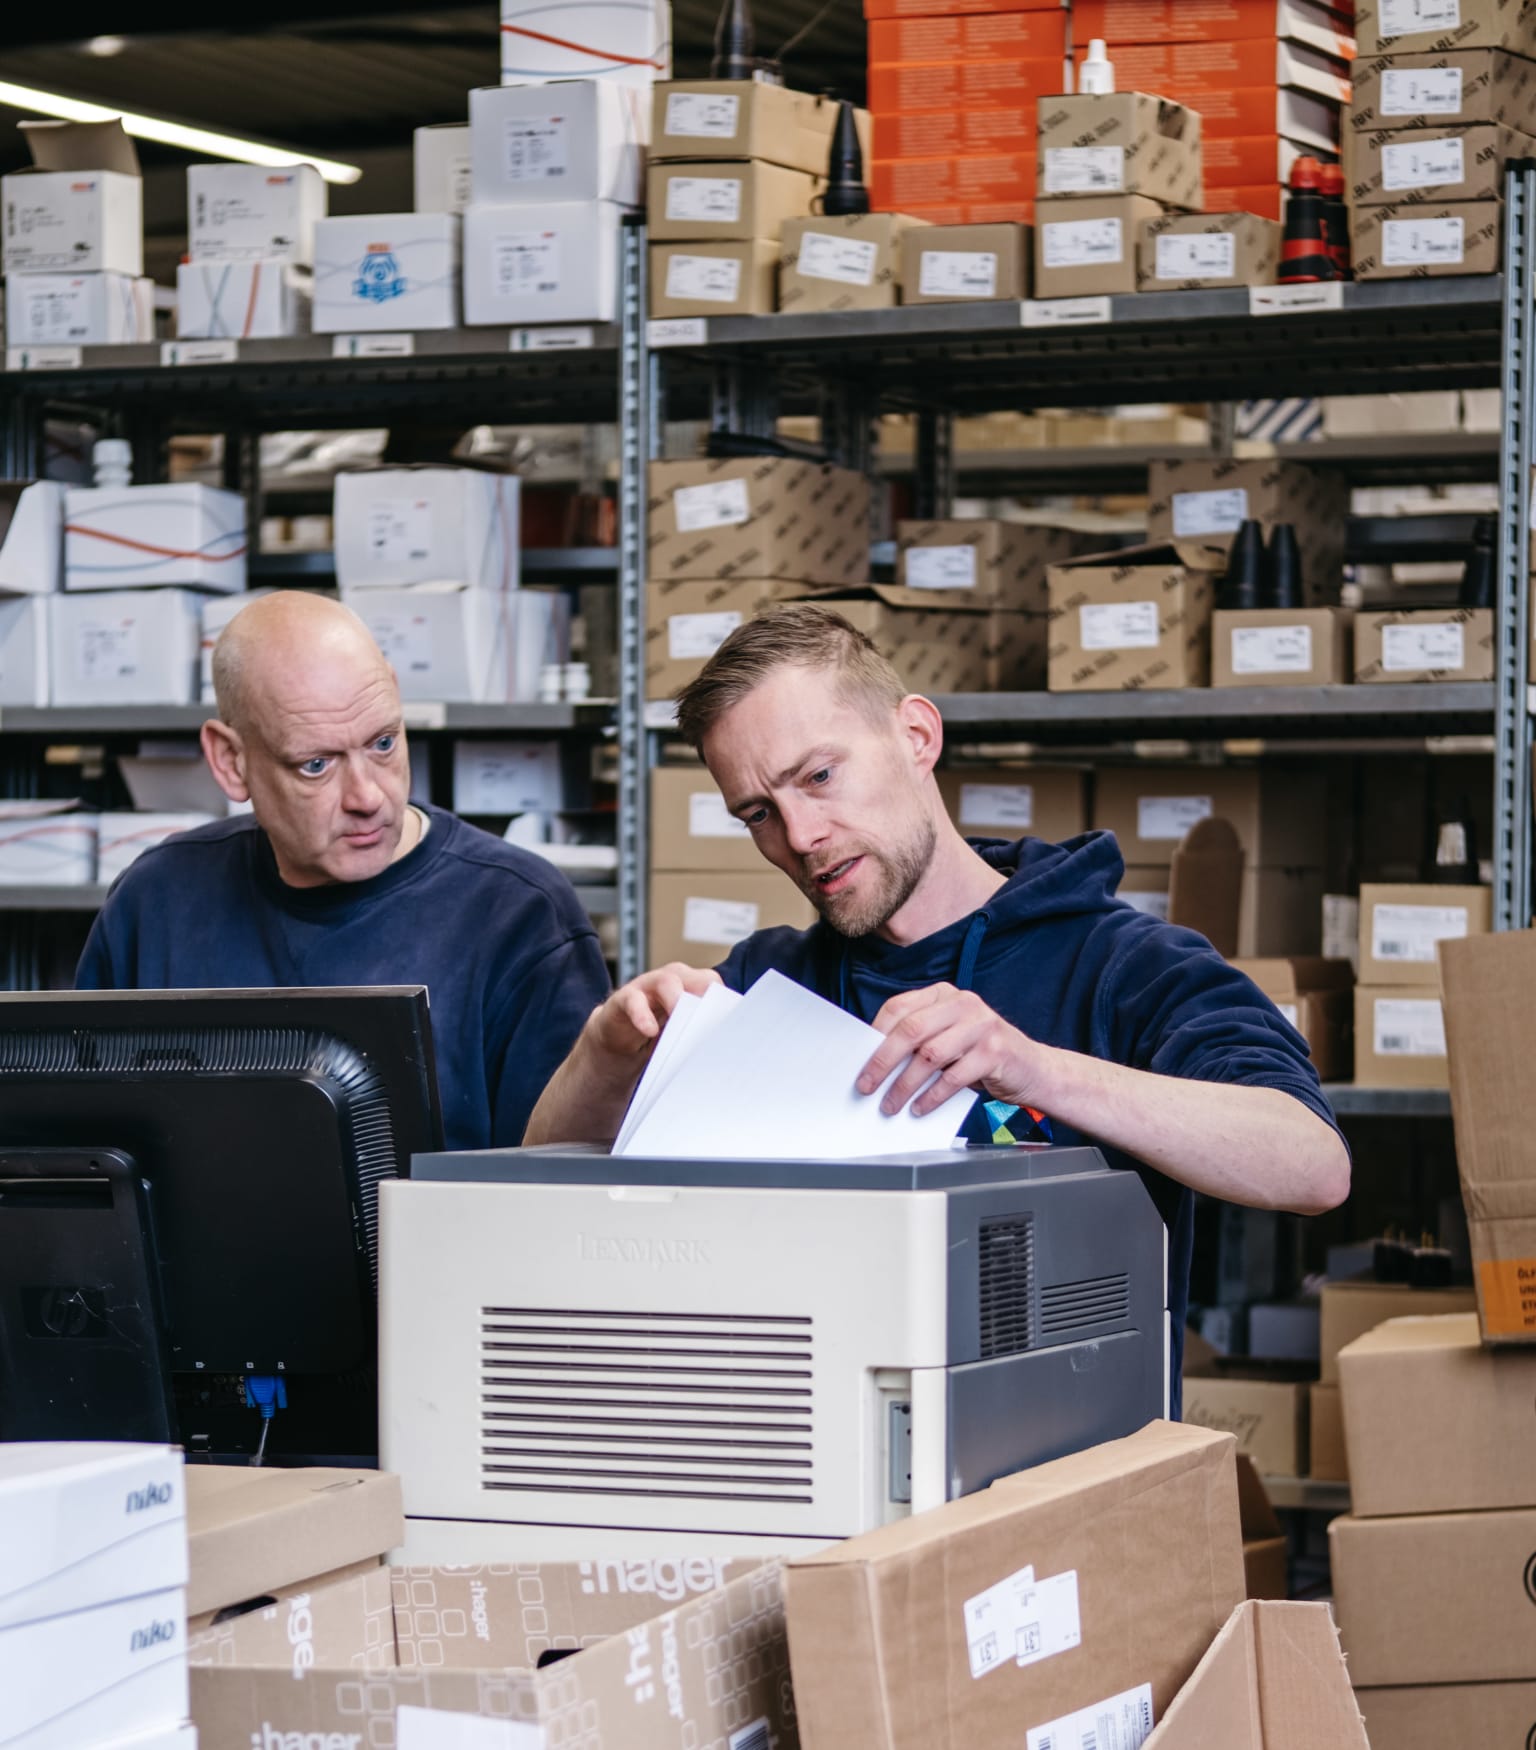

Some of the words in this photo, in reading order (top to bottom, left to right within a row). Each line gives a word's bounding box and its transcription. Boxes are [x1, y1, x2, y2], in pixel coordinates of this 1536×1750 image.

[577, 1231, 712, 1272] LEXMARK
[126, 1481, 172, 1513] niko
[130, 1619, 175, 1651] niko
